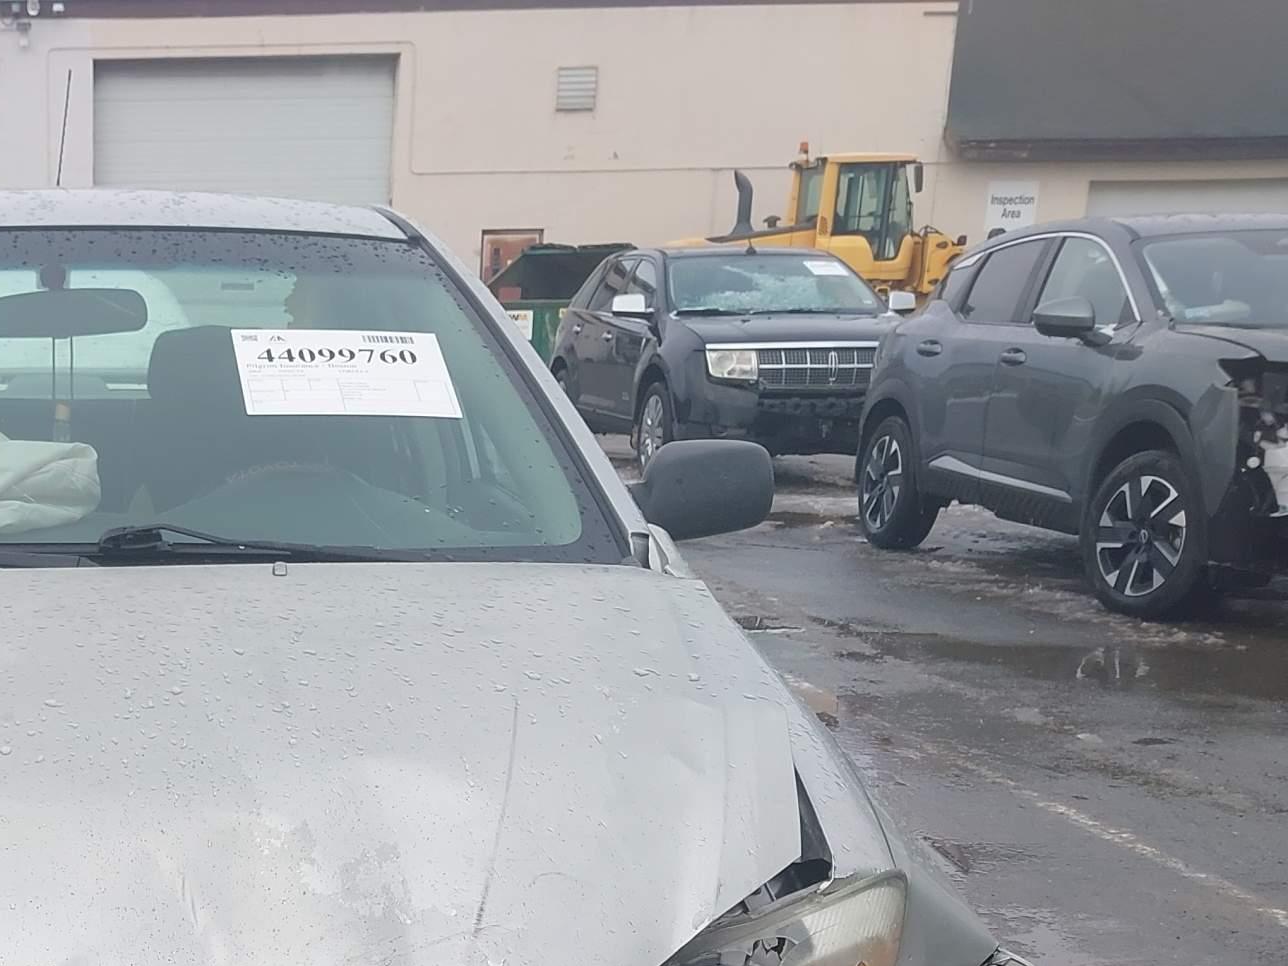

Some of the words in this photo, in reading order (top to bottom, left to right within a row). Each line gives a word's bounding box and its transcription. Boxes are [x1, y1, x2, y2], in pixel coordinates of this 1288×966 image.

[990, 194, 1035, 206] Inspection
[1001, 208, 1021, 219] Area
[256, 347, 417, 365] 44099760
